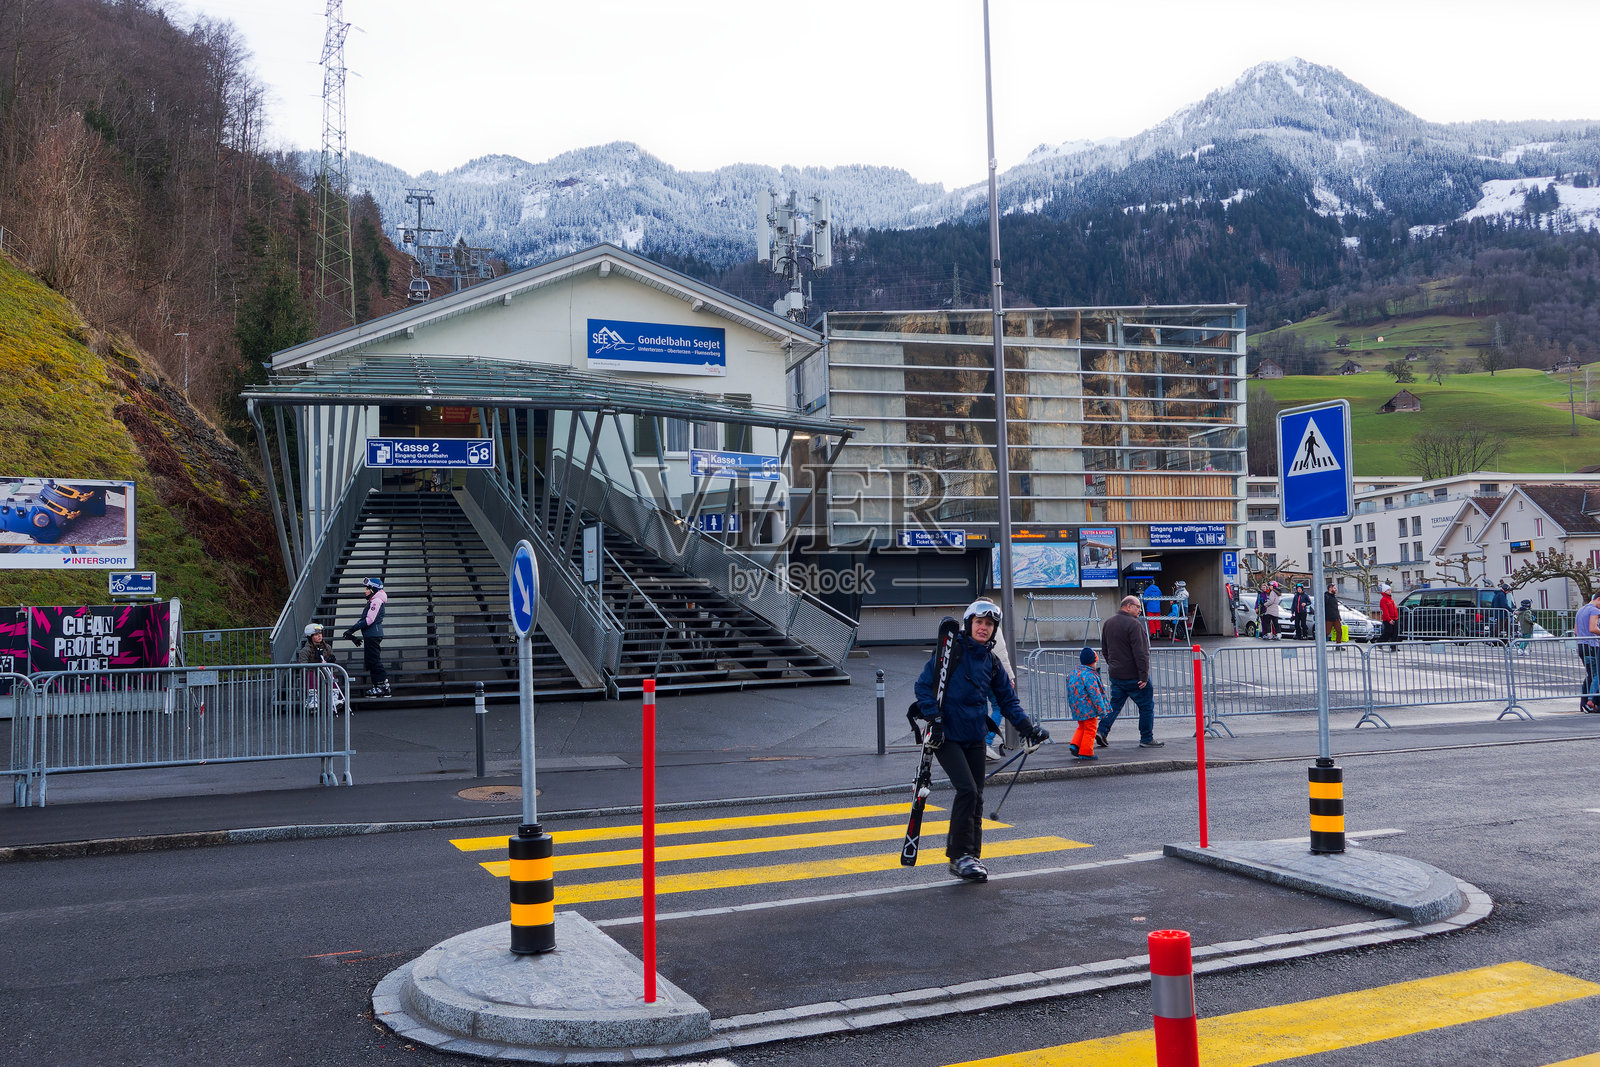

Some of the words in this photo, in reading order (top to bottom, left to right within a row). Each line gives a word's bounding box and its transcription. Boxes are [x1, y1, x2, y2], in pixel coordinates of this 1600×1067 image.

[592, 332, 609, 345] SEE
[638, 335, 691, 348] Gondelbahn
[394, 442, 430, 452] Kasse
[432, 442, 440, 452] 2
[479, 448, 489, 460] 8
[710, 454, 736, 465] Kasse
[1150, 525, 1173, 533] Eingang
[71, 557, 128, 565] INTERSPORT
[62, 614, 114, 636] CLEAN
[54, 635, 121, 658] PROTECT
